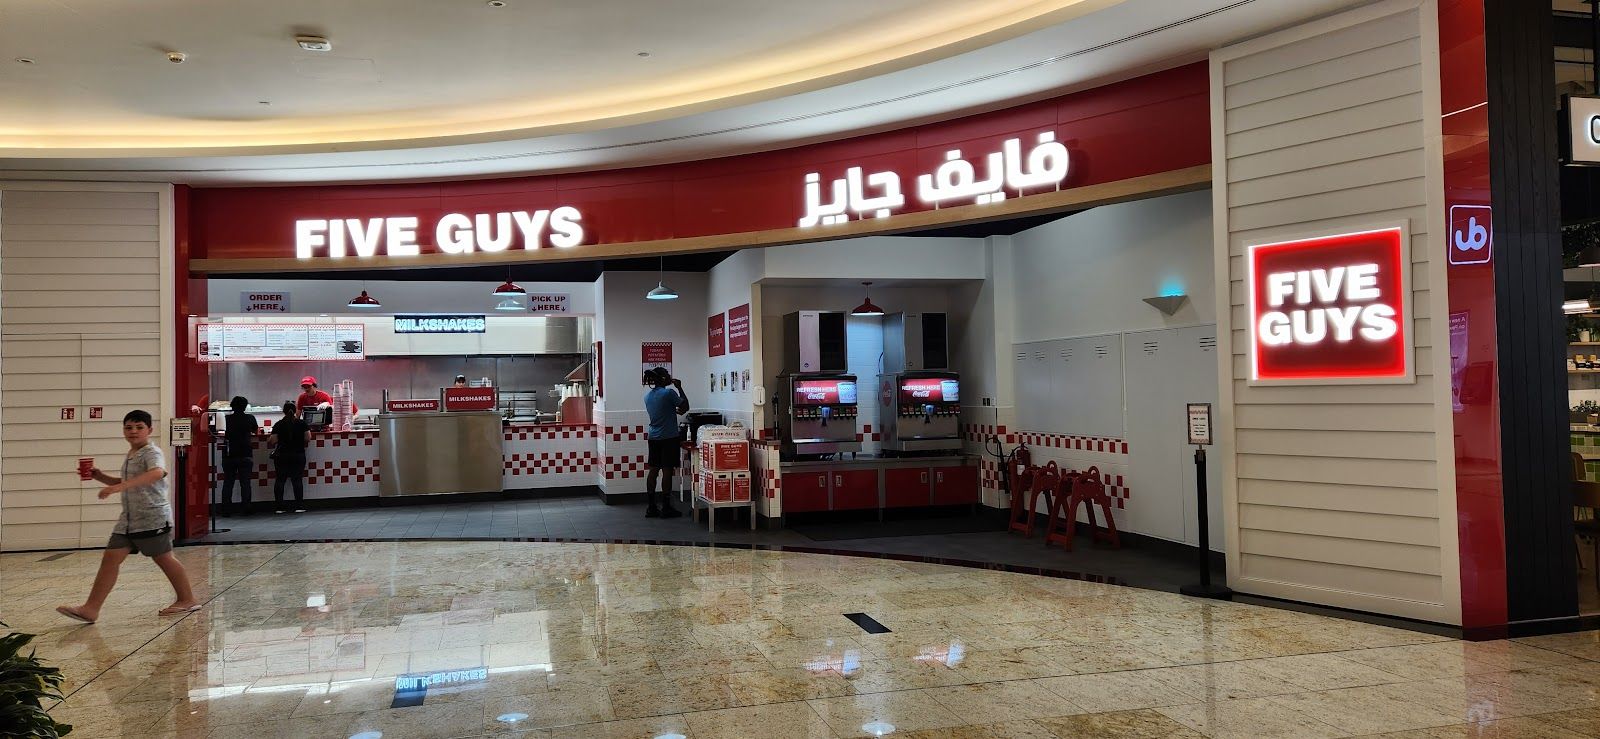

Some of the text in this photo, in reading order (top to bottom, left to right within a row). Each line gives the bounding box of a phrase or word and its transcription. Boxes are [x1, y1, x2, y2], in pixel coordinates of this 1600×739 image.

[798, 131, 1069, 227] فايف جايز
[296, 206, 583, 258] FIVE GUYS
[1268, 263, 1380, 307] FIVE
[395, 318, 485, 332] MILKSHAKES
[1259, 303, 1397, 345] GUYS
